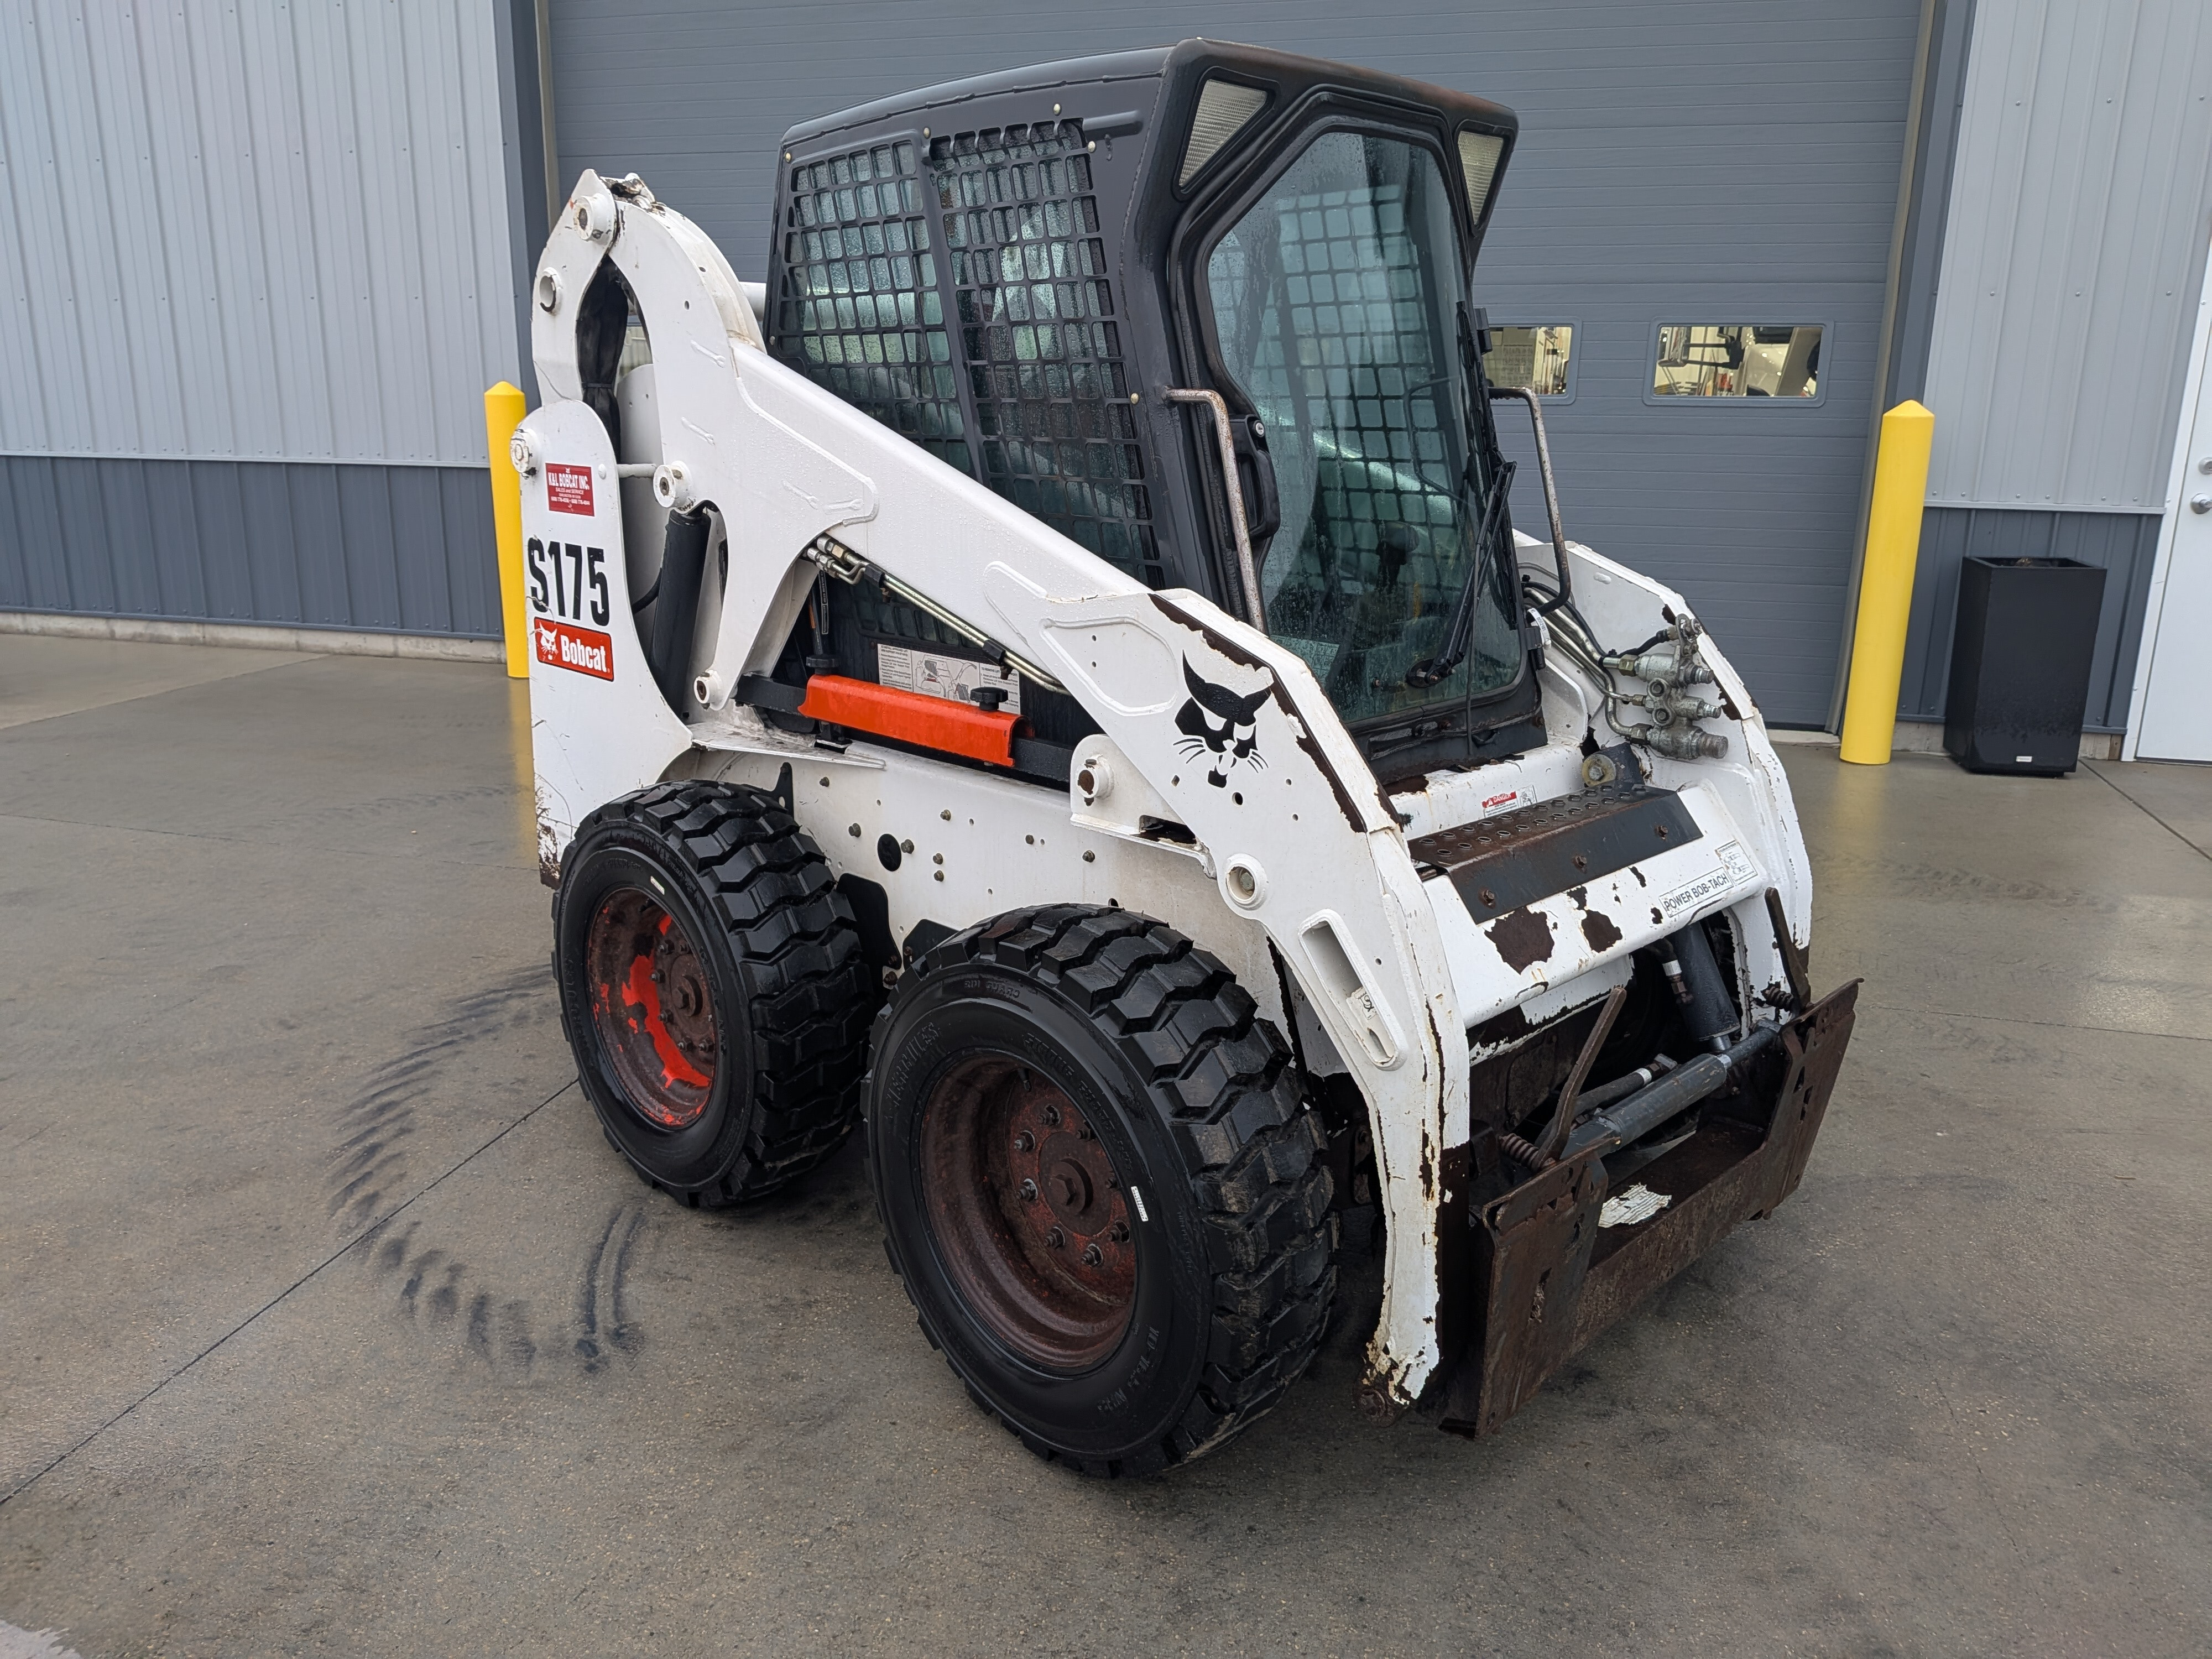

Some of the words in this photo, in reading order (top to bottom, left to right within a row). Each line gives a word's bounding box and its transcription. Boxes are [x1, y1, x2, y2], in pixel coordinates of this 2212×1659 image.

[559, 473, 578, 488] BOBCAT
[528, 537, 609, 627] S175
[560, 634, 607, 672] Bobcat
[1663, 890, 1694, 911] POWER
[1691, 873, 1730, 898] BOB-TACH
